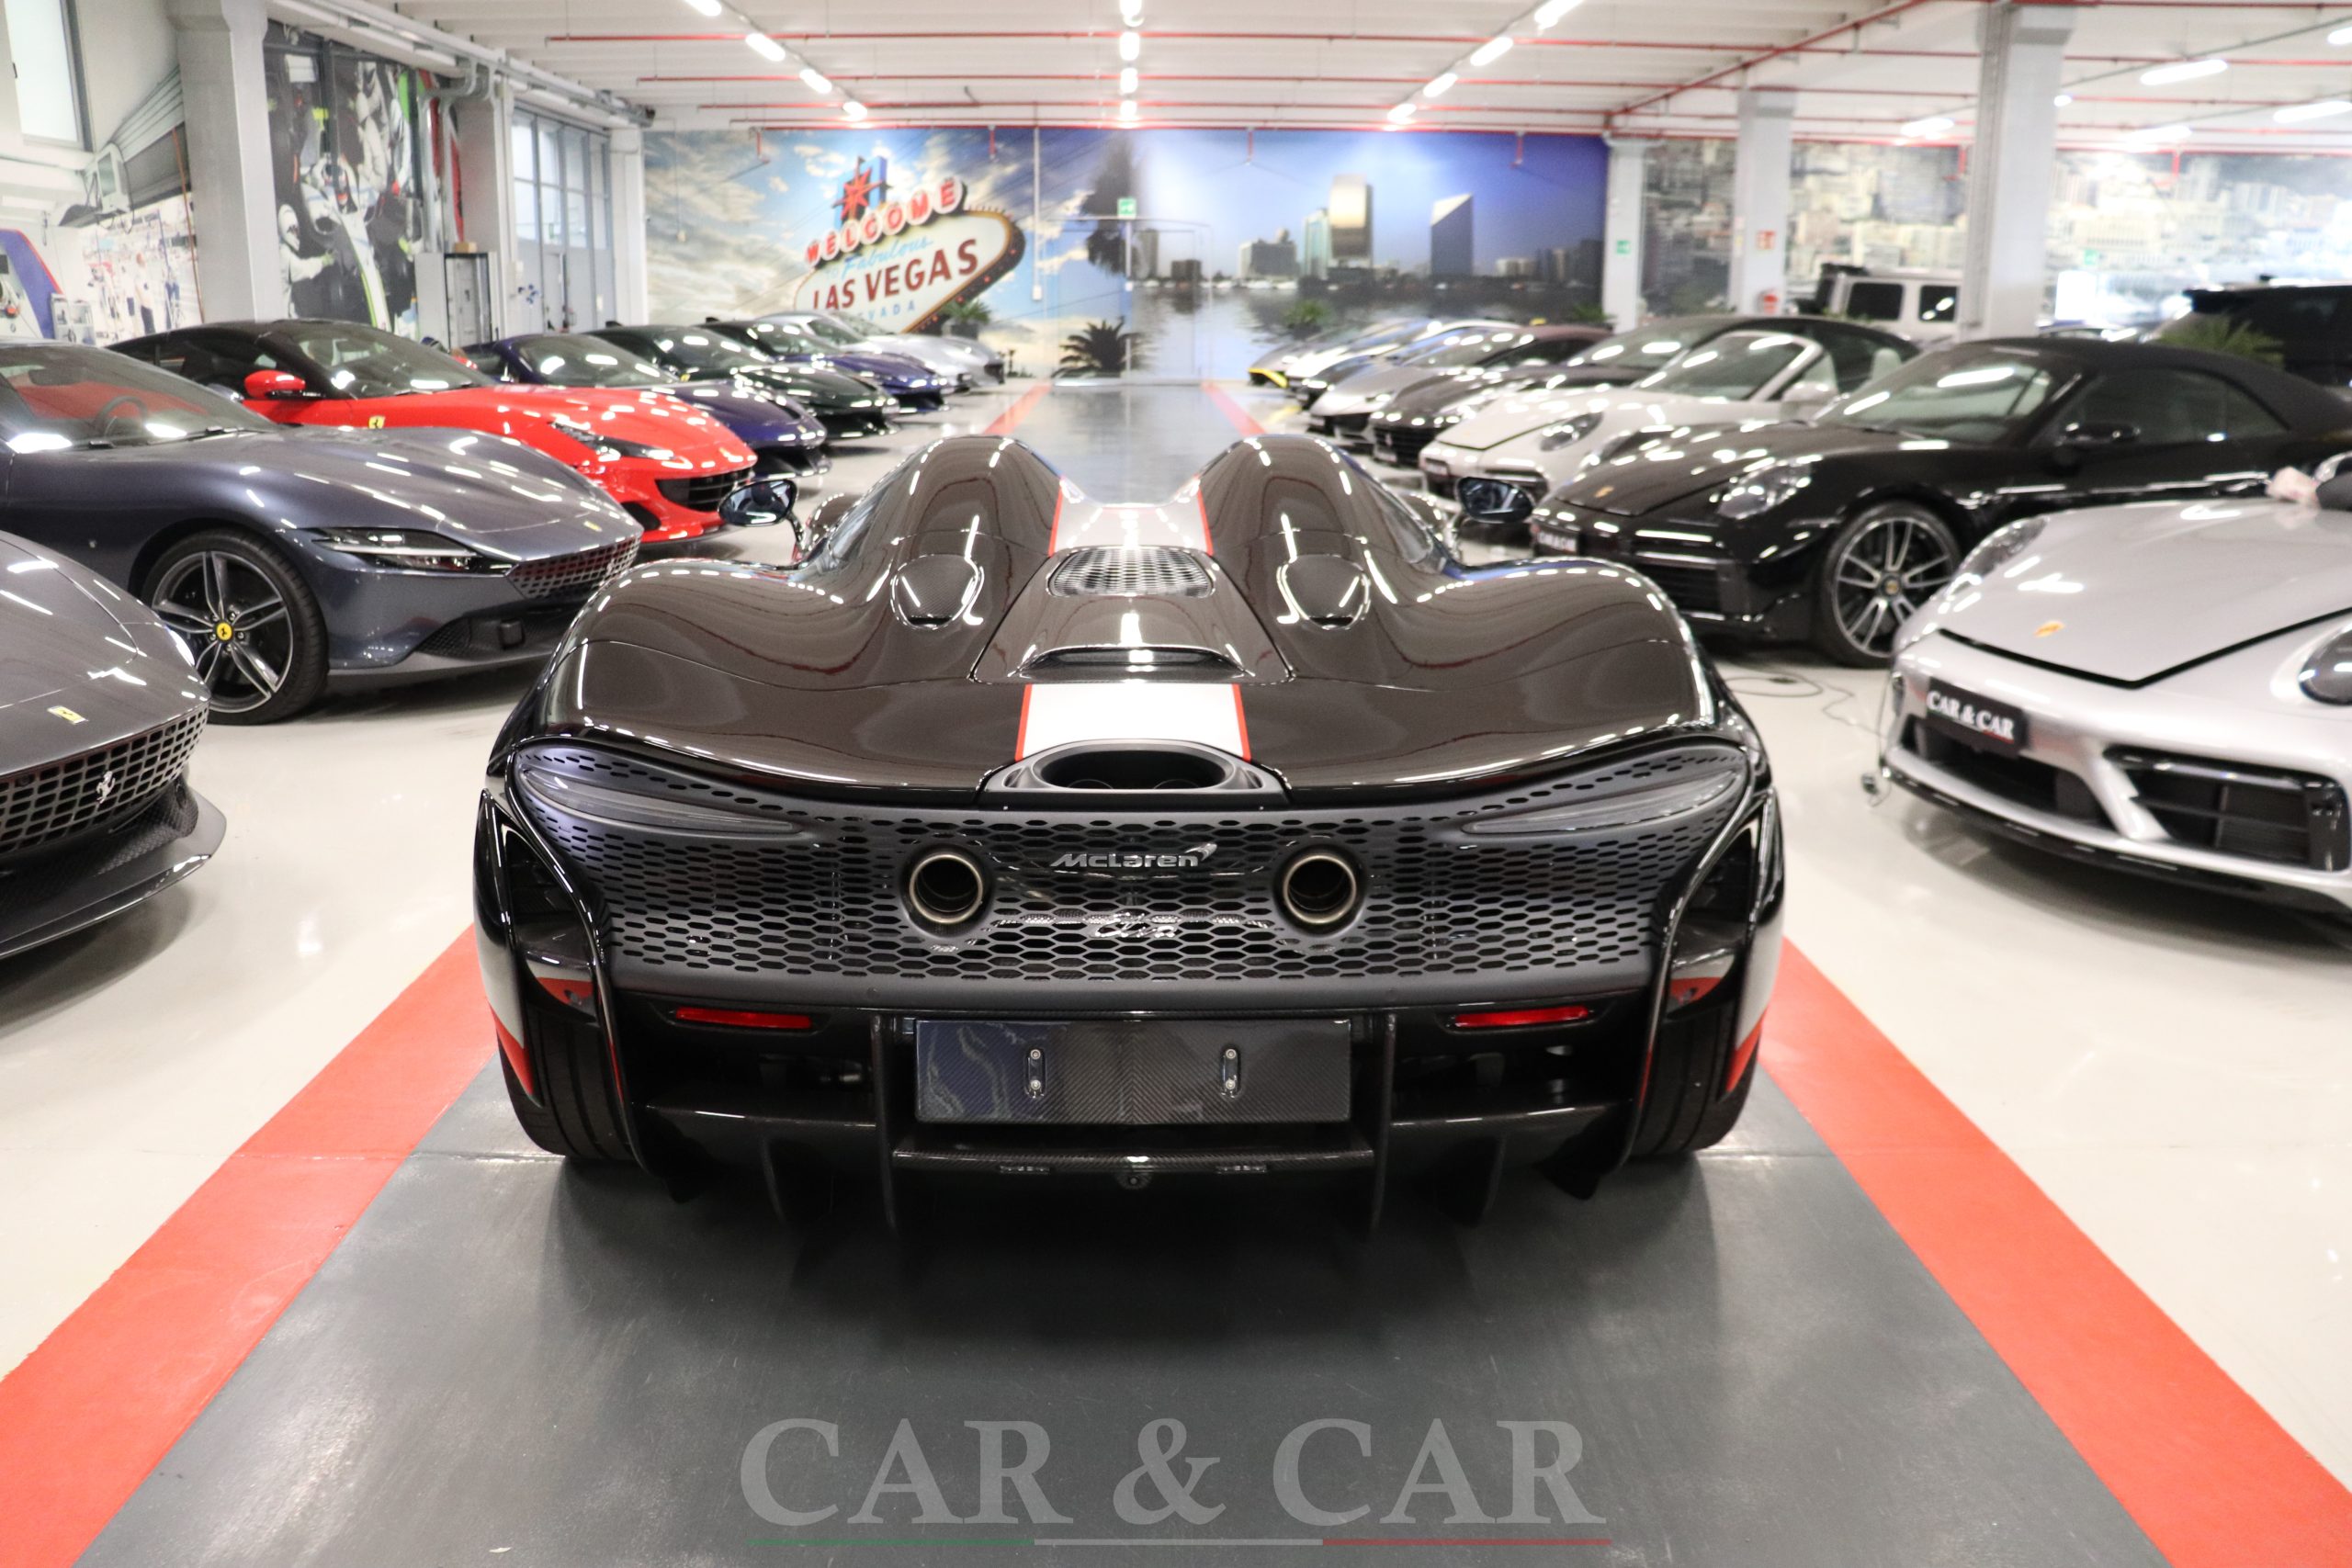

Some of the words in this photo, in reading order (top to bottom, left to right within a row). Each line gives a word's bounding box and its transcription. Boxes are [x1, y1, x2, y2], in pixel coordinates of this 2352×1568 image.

[806, 178, 956, 263] WELCOME
[812, 278, 855, 310] LAS
[865, 238, 978, 302] VEGAS
[842, 236, 933, 278] Fabulous
[1927, 690, 1960, 717] CAR
[1960, 705, 1975, 725] &
[1975, 709, 2014, 740] CAR
[1050, 852, 1199, 868] McLaren
